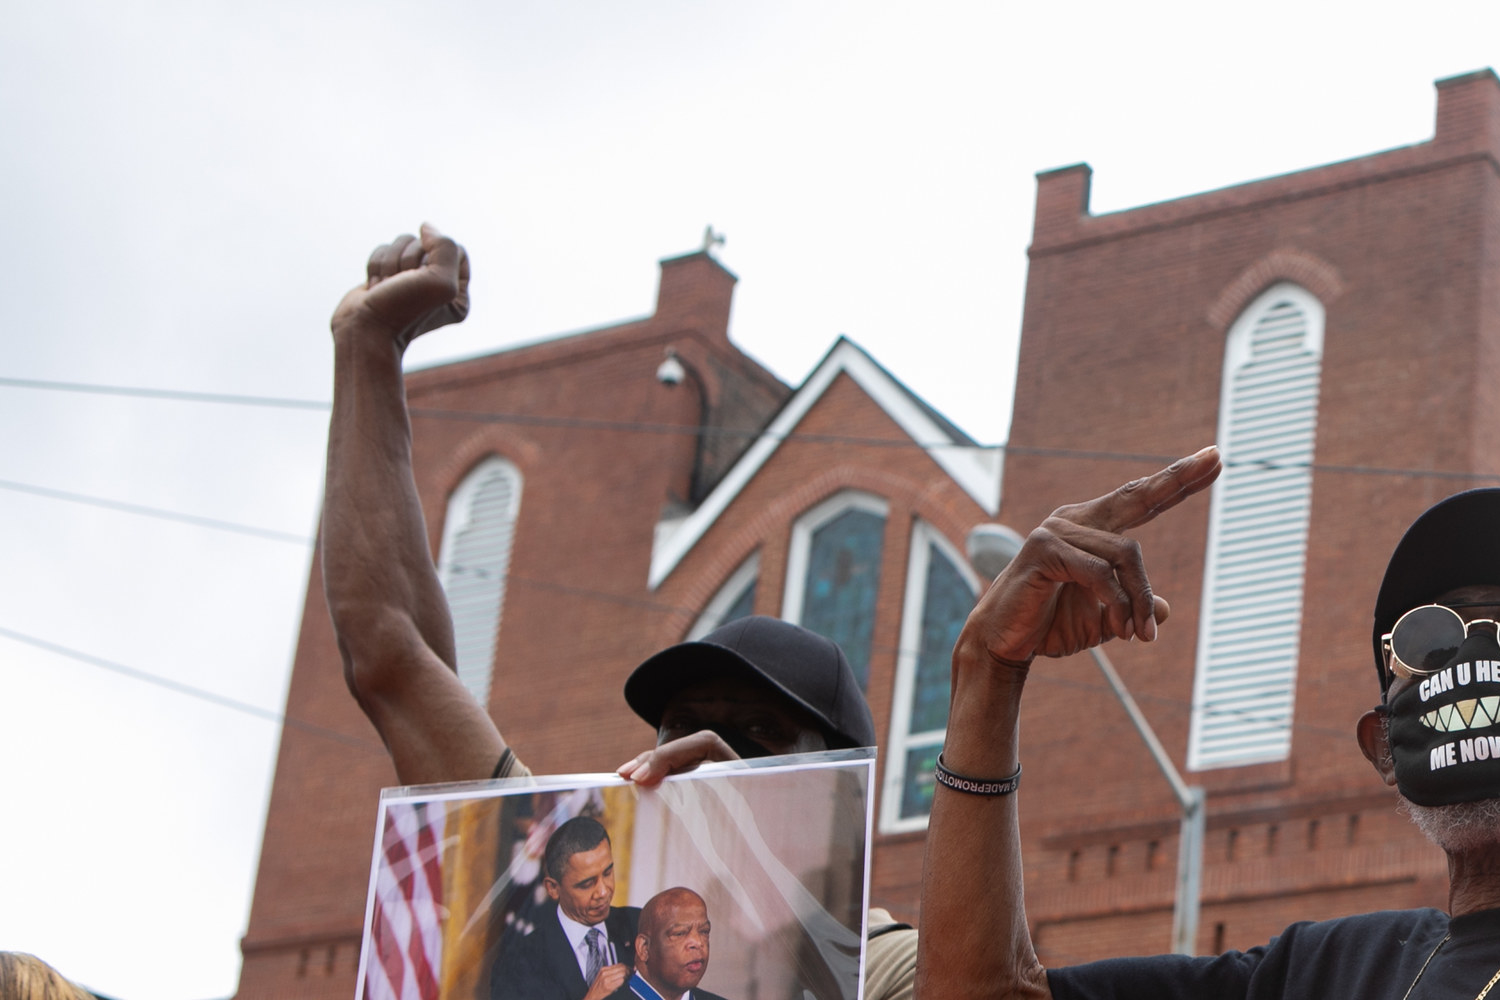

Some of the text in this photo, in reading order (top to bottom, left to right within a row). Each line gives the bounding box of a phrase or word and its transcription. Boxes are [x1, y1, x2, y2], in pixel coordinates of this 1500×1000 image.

[1419, 667, 1454, 702] CAN
[1456, 662, 1472, 686] U
[1430, 742, 1457, 771] ME
